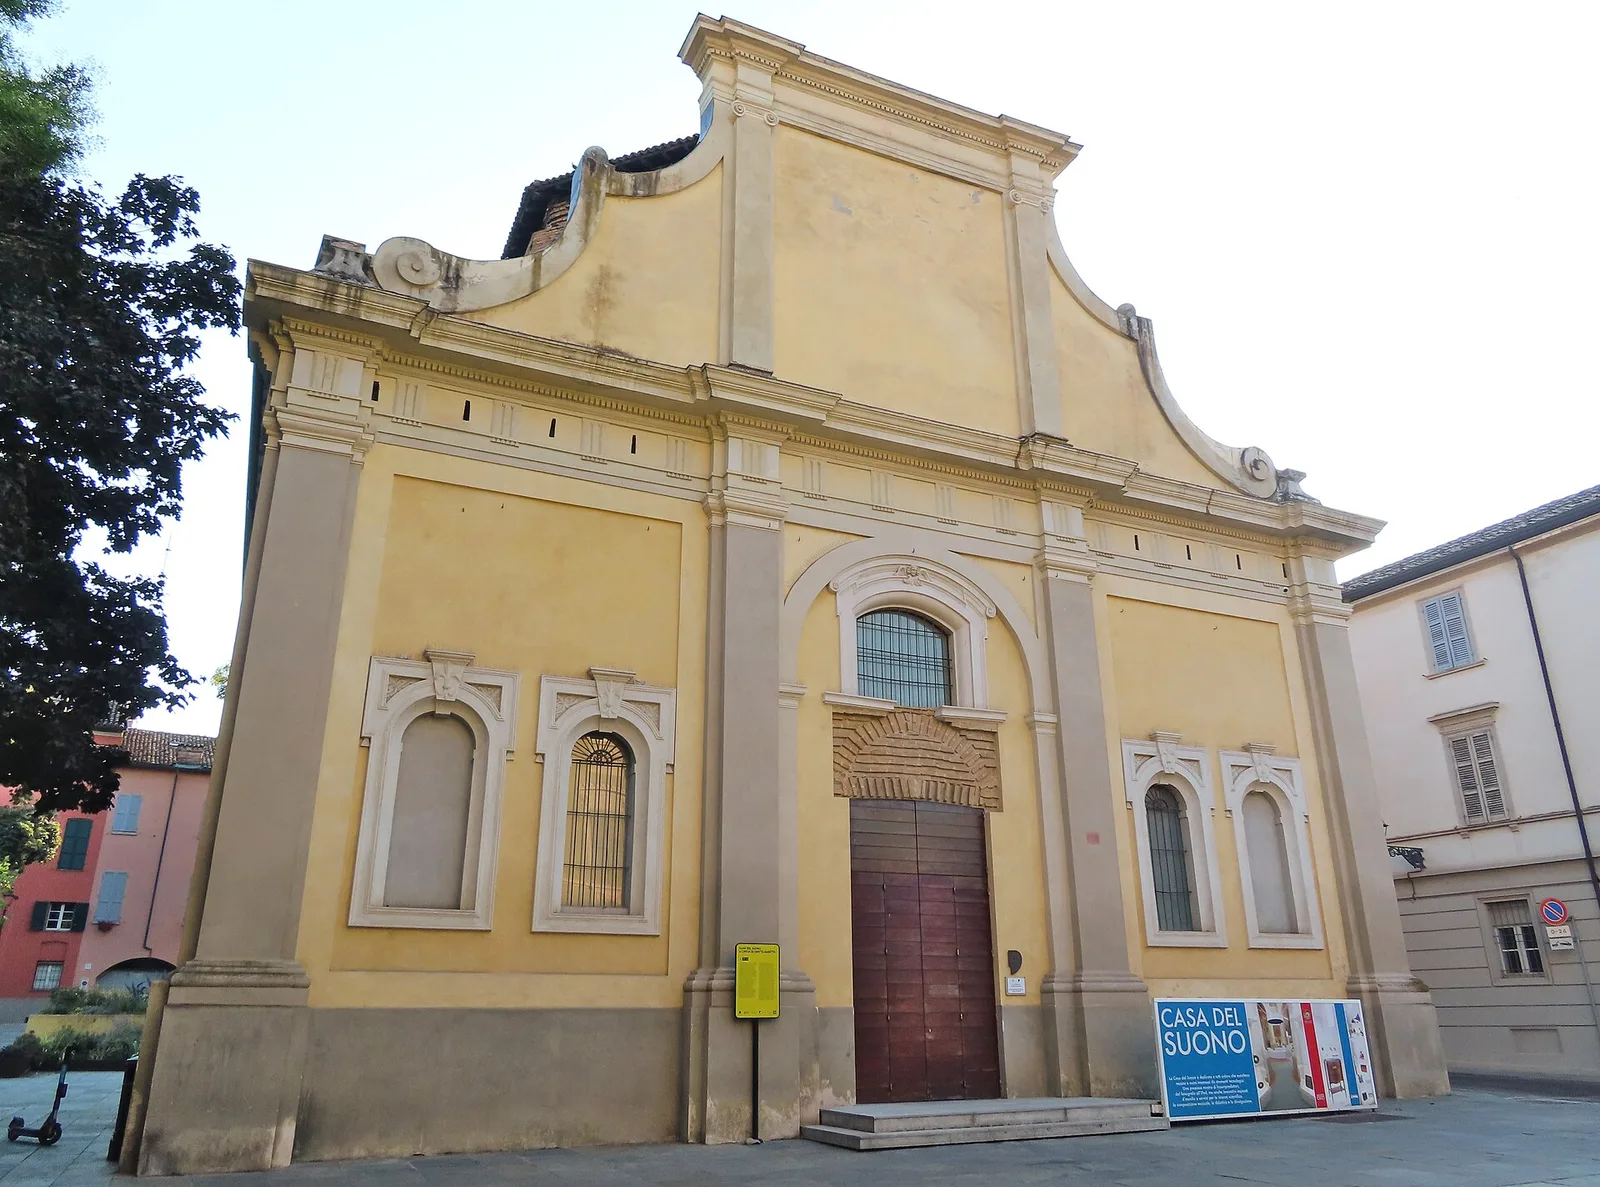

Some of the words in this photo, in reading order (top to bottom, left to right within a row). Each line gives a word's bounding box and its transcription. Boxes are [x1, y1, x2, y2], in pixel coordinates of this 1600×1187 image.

[1161, 1007, 1209, 1028] CASA
[1212, 1007, 1242, 1027] DEL
[1164, 1029, 1246, 1056] SUONO
